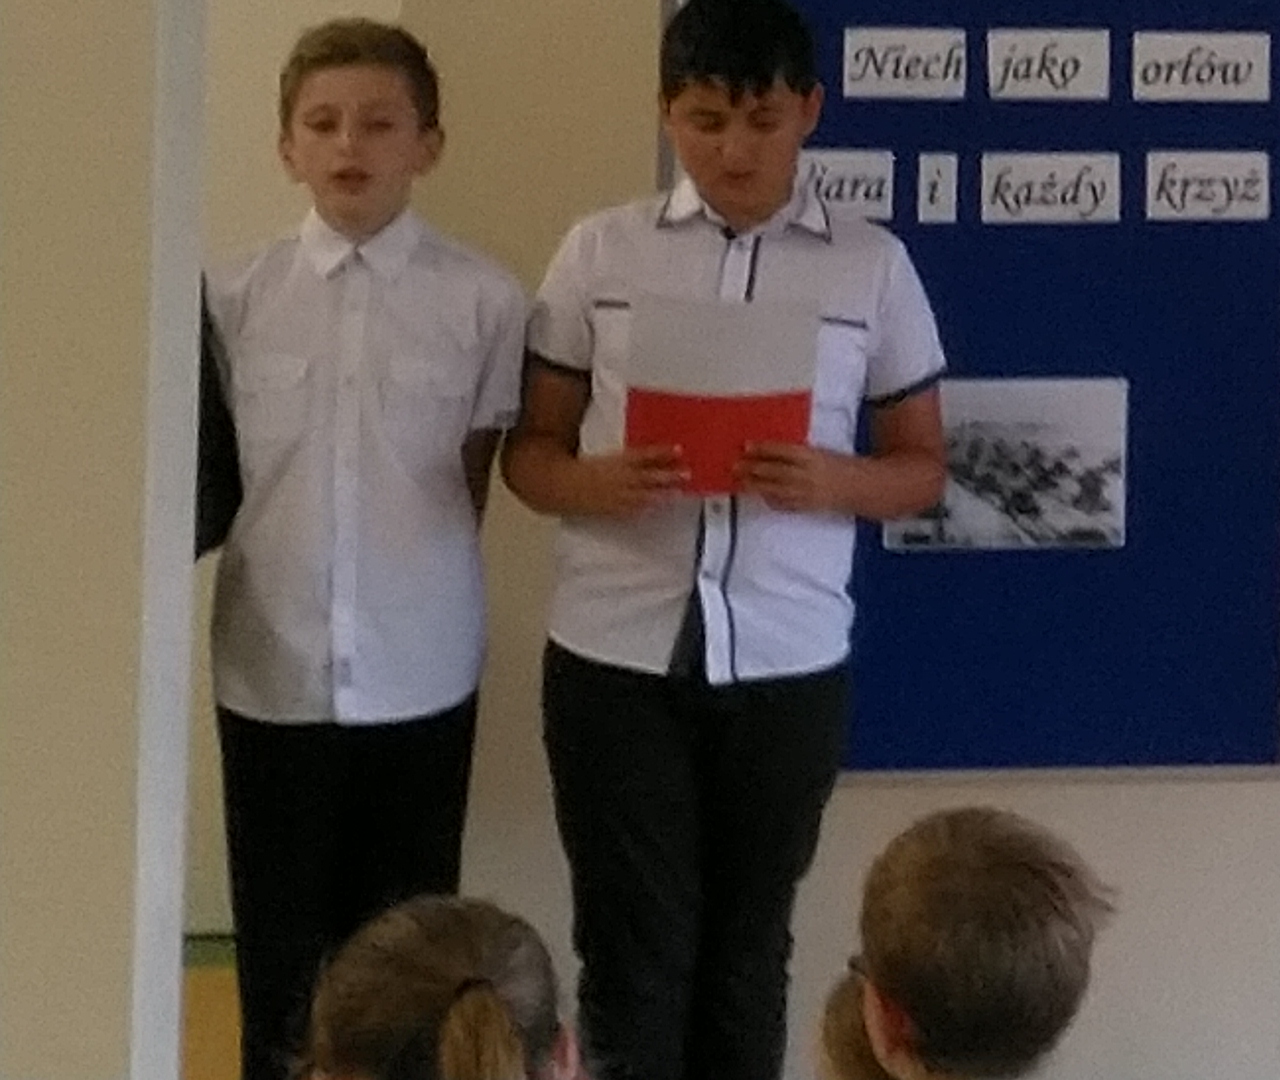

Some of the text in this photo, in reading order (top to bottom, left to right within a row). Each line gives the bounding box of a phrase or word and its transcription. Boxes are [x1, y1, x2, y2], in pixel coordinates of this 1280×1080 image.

[849, 46, 966, 83] Niech
[996, 44, 1081, 90] jako
[808, 162, 886, 202] iara
[988, 168, 1107, 216] każdy
[1154, 162, 1261, 215] krzyż
